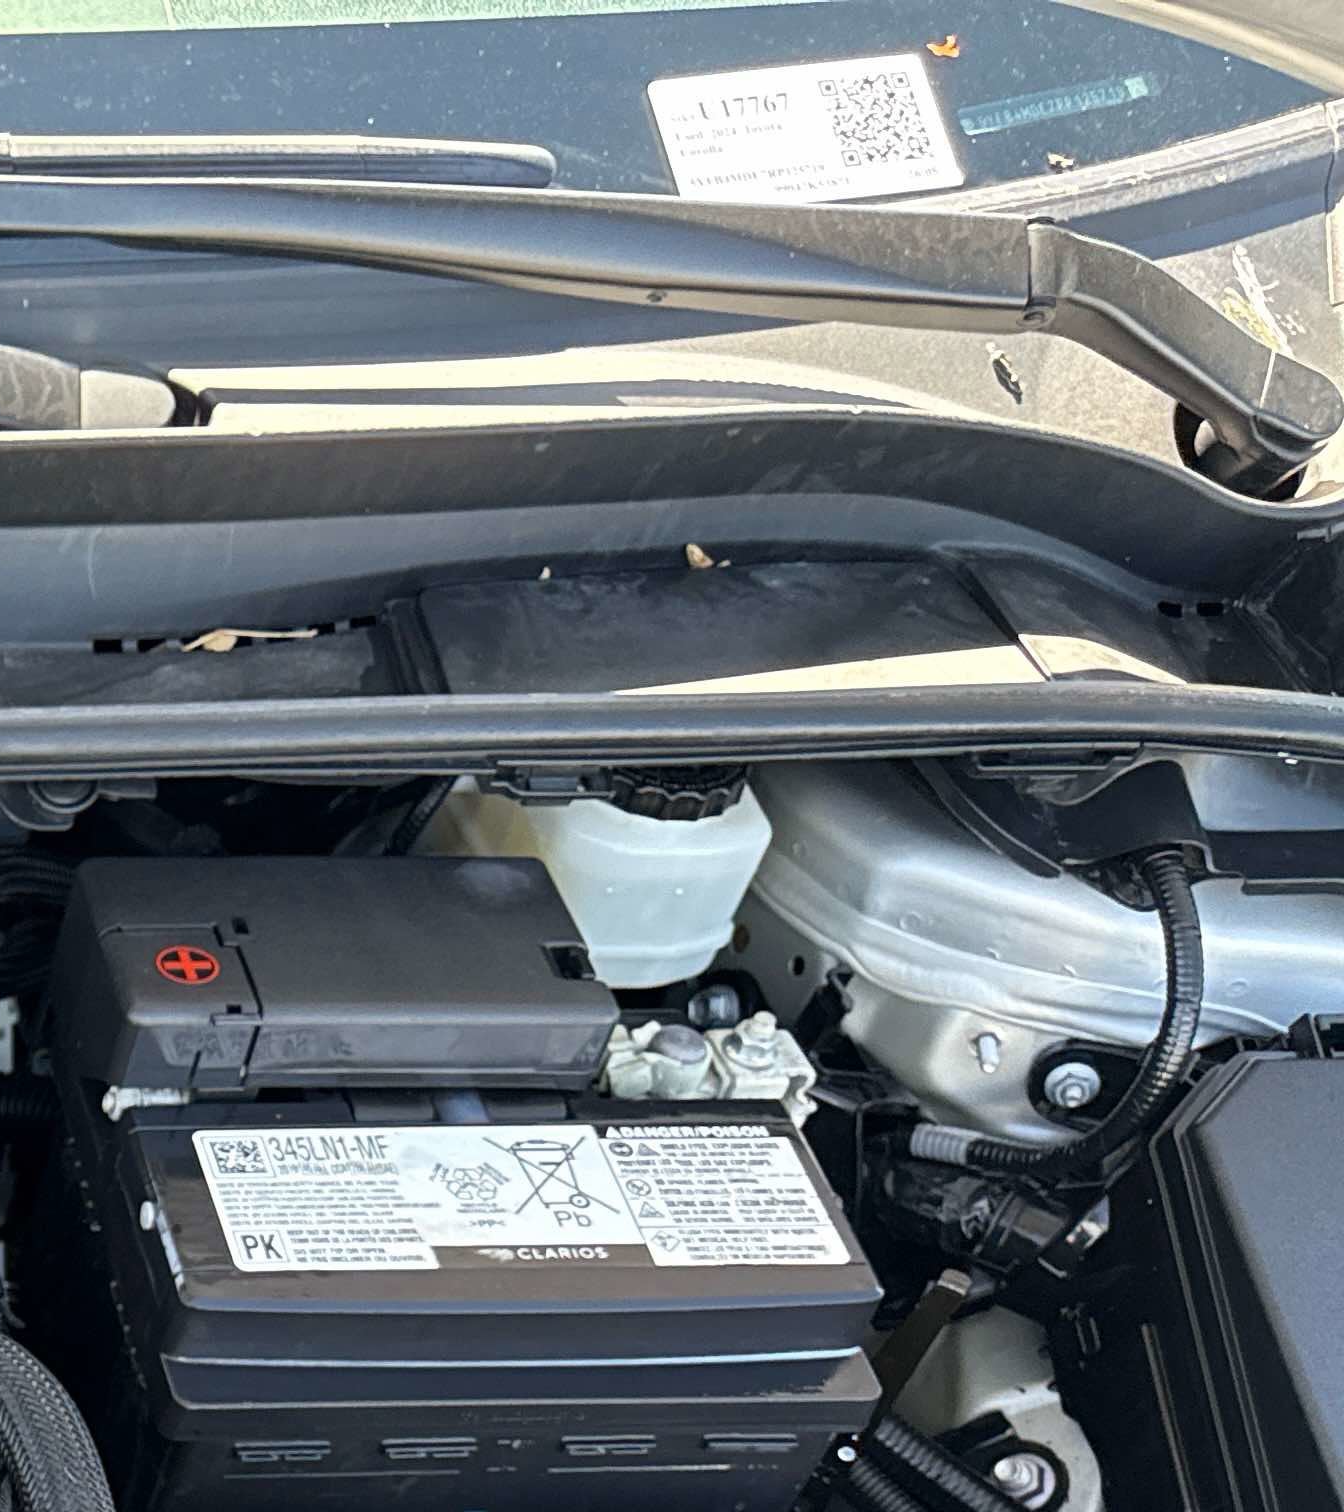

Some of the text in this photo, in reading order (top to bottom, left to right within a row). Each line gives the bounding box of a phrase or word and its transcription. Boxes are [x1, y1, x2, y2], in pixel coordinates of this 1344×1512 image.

[268, 1134, 389, 1161] 345LN1-MF
[553, 1210, 592, 1228] Pb
[240, 1233, 283, 1260] PK
[516, 1246, 610, 1260] CLARIOS
